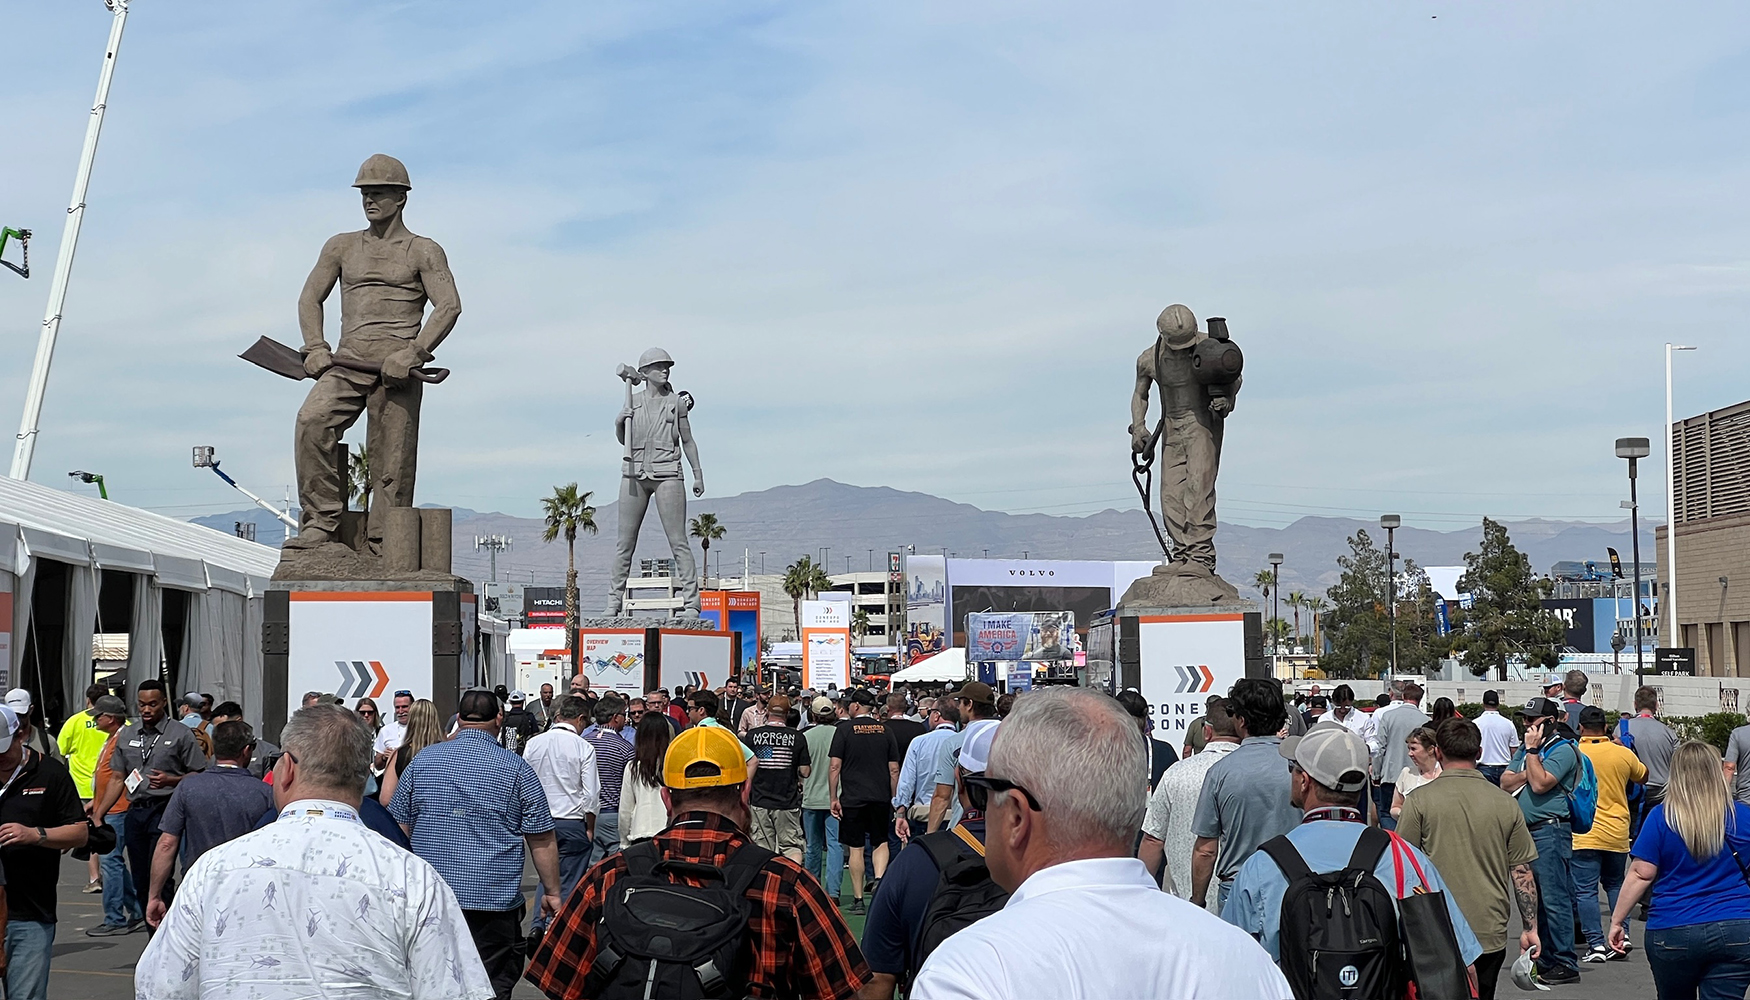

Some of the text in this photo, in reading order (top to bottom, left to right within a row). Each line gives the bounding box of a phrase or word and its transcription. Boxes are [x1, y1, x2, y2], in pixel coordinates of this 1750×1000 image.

[984, 620, 1012, 629] I MAKE
[979, 630, 1017, 639] AMERICA
[1148, 703, 1199, 715] CONE
[753, 732, 795, 741] MORGAN
[754, 738, 794, 747] WALLEN
